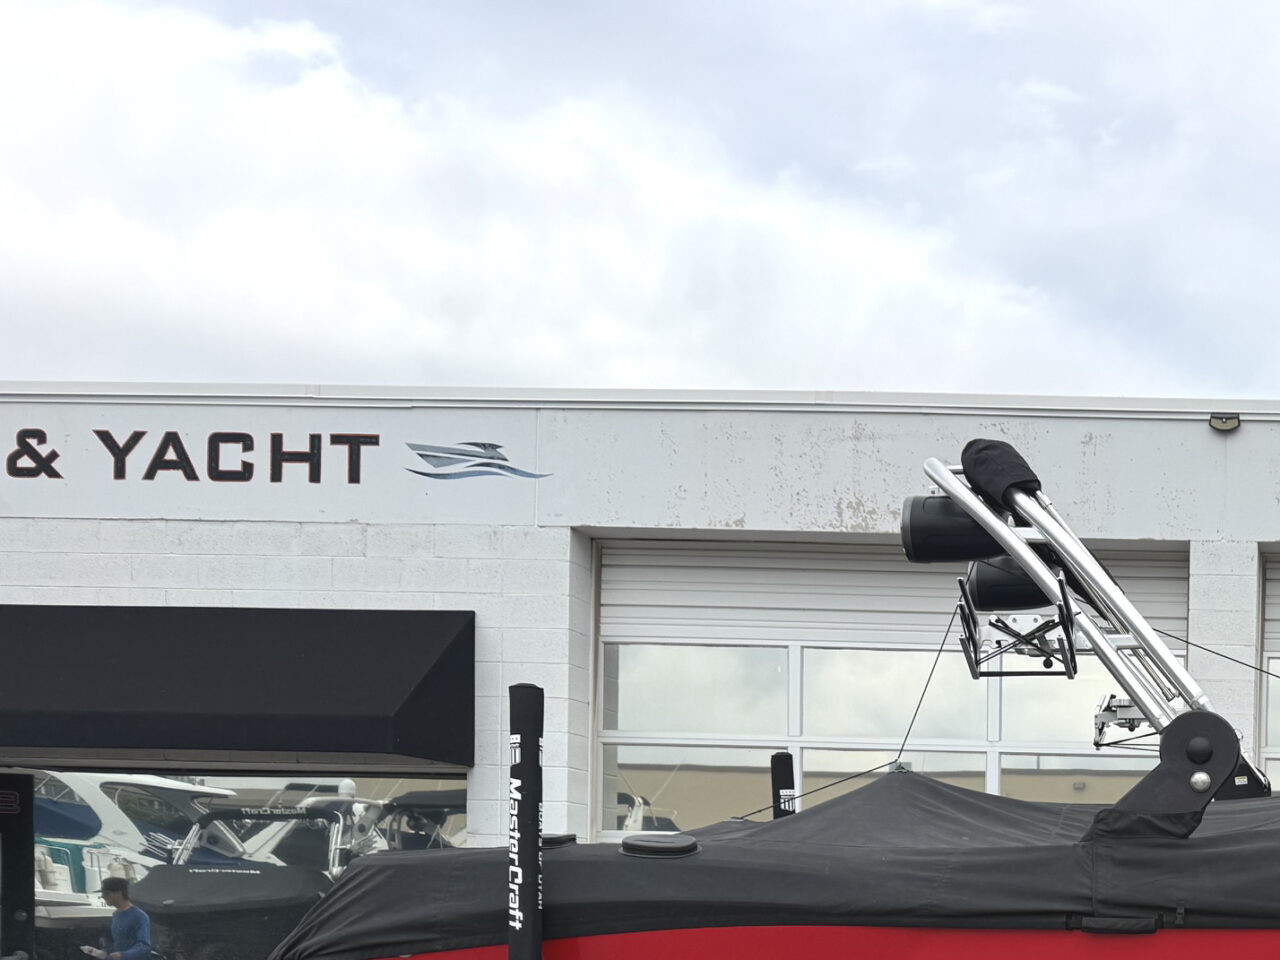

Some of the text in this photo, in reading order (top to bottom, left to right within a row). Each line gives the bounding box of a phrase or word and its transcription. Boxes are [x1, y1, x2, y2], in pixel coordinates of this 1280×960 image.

[5, 428, 380, 485] & YACHT
[508, 777, 524, 931] MasterCraft
